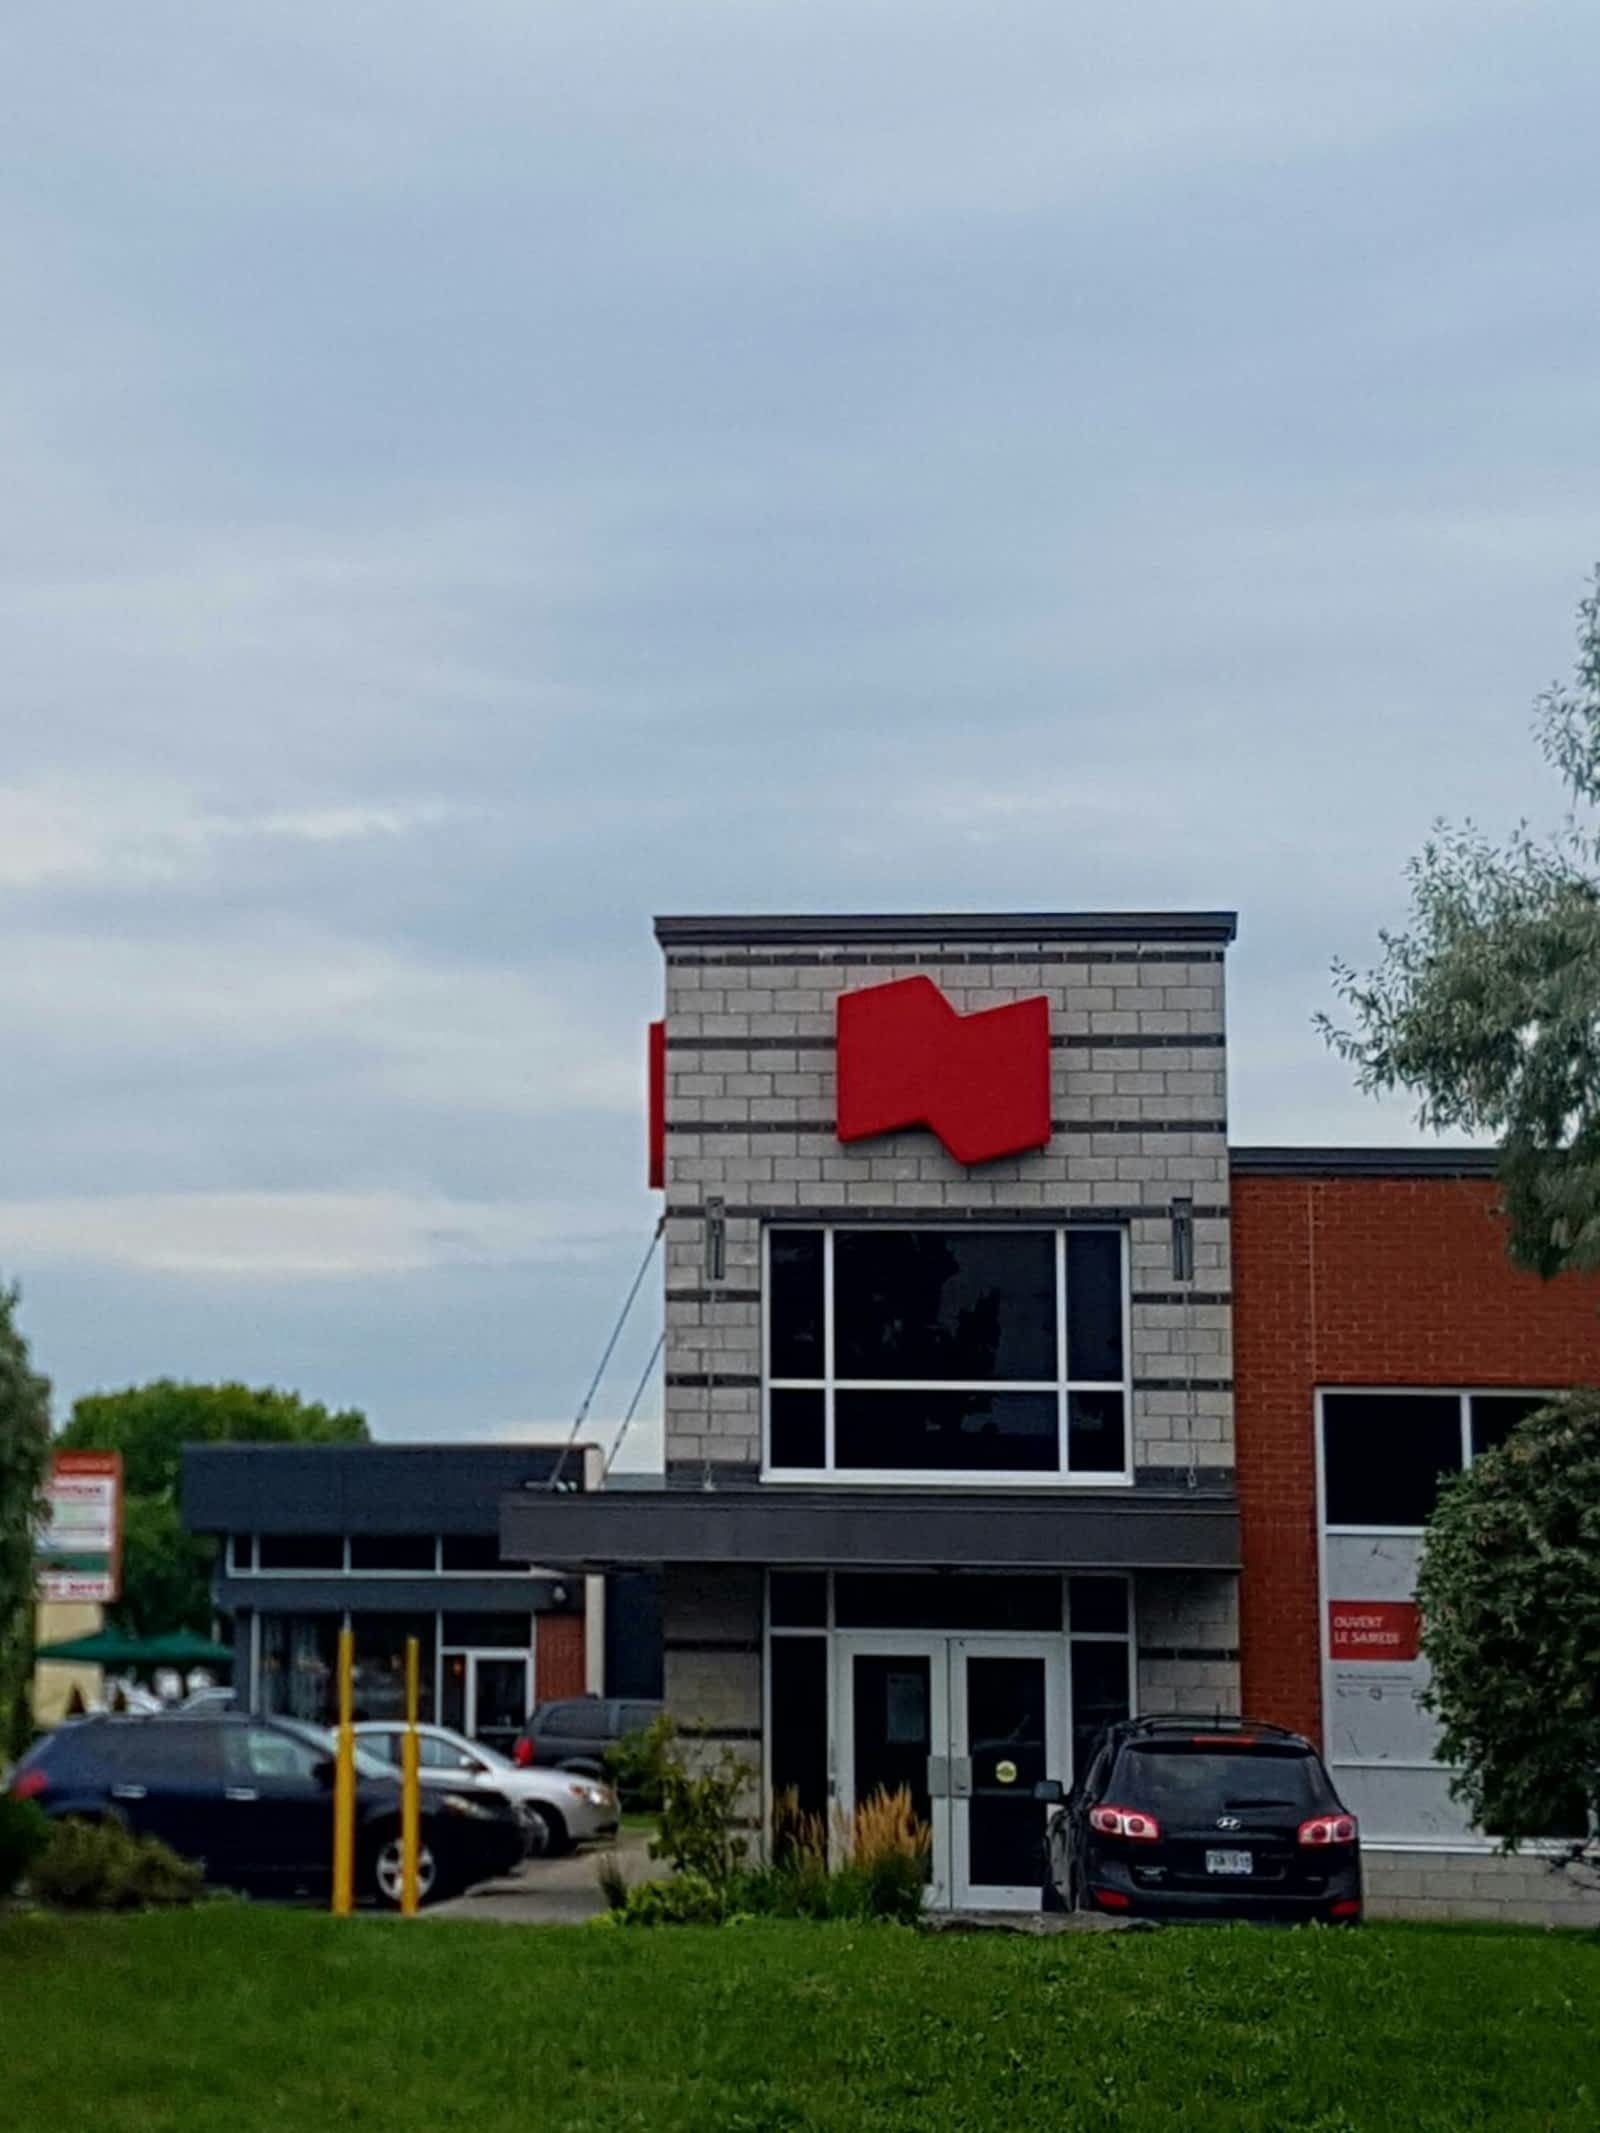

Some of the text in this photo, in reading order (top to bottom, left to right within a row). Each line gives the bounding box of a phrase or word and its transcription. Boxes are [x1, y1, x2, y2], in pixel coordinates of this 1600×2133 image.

[1334, 1616, 1382, 1628] OUVERT
[1334, 1632, 1399, 1644] LE SAMEDI
